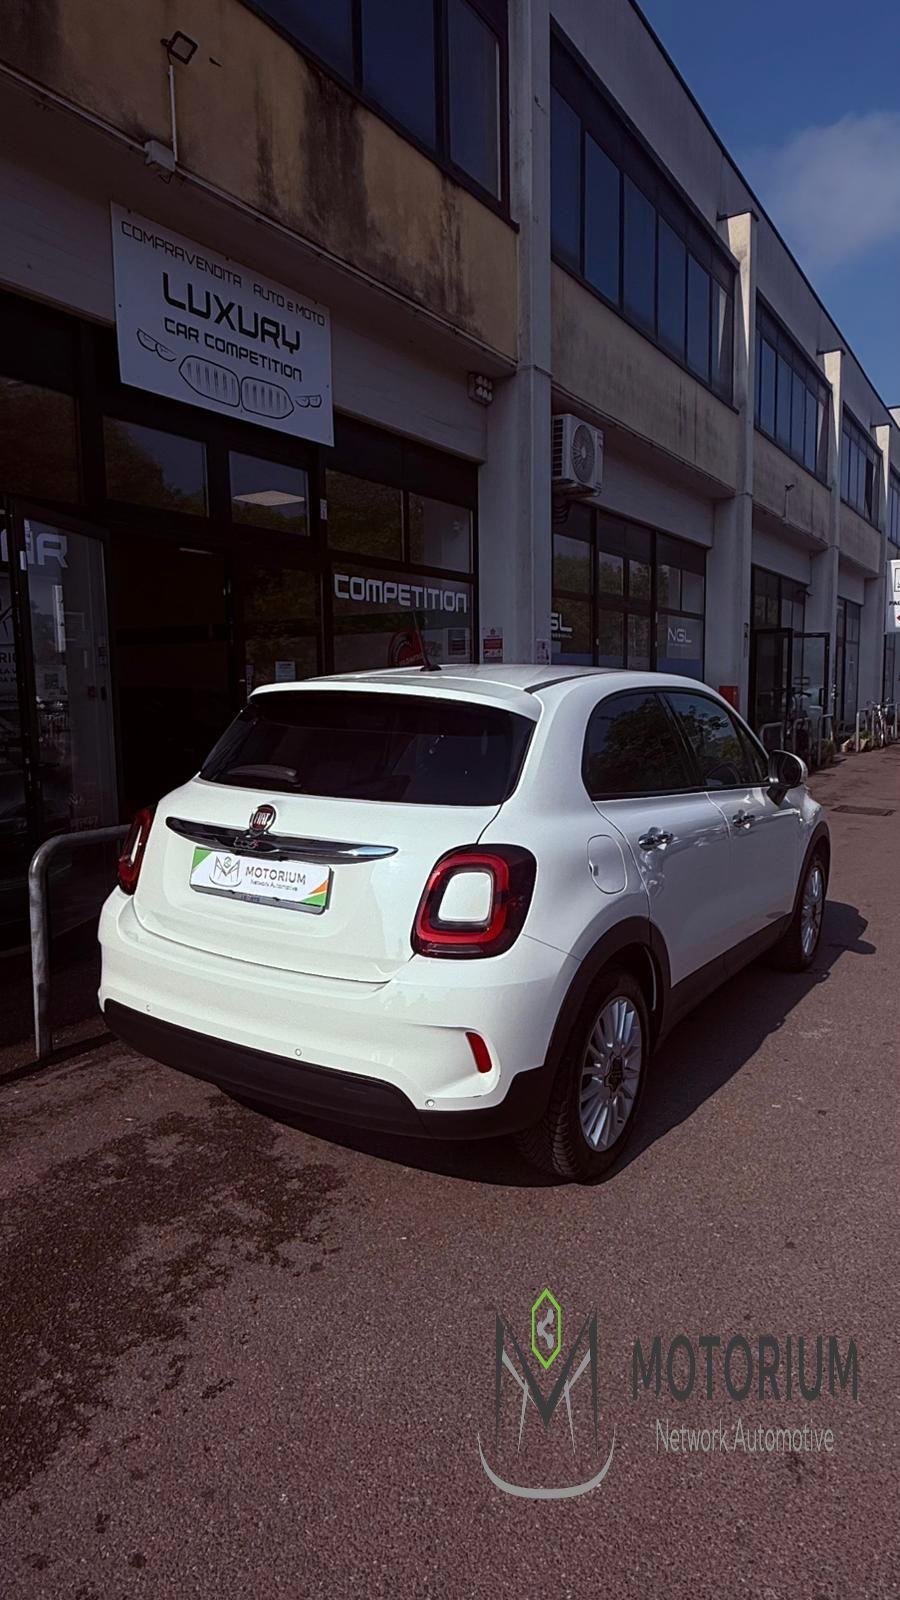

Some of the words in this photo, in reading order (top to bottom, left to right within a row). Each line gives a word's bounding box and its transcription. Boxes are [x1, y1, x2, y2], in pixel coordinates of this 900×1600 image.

[121, 220, 242, 289] COMPRAVENDITA
[253, 284, 285, 309] AUTO
[296, 303, 325, 327] MOTO
[162, 271, 301, 355] LUXURY
[164, 316, 199, 345] CAR
[204, 332, 303, 383] COMPETITION
[333, 573, 467, 614] COMPETITION
[667, 626, 693, 644] NGL
[253, 811, 271, 826] FIAT
[245, 866, 306, 885] MOTORIUM
